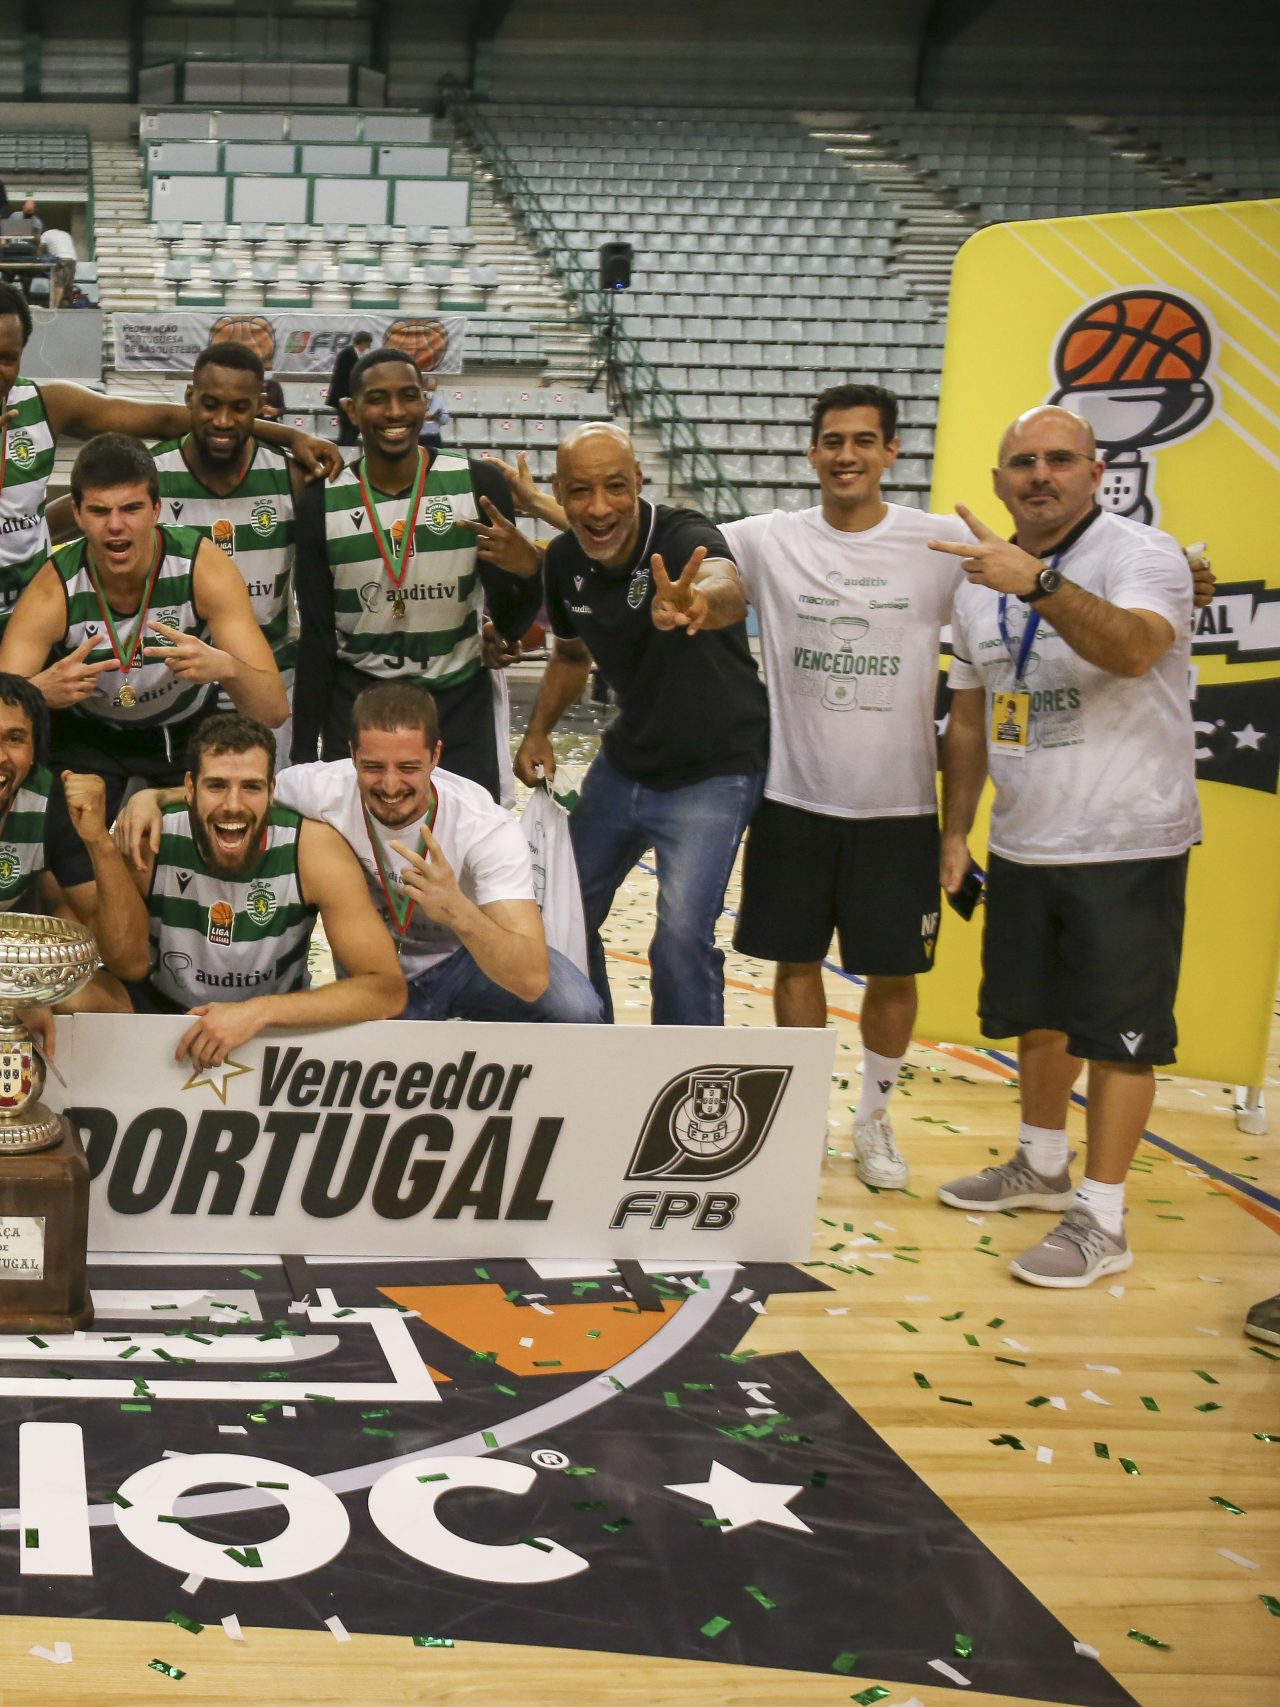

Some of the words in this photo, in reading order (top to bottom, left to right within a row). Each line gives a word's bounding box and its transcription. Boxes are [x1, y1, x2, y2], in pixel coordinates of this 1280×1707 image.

[385, 582, 456, 602] auditiv
[798, 593, 840, 608] macron
[156, 609, 177, 618] SCP
[793, 645, 902, 677] VENCEDORES
[250, 881, 272, 890] SCP
[211, 926, 230, 937] LIGA
[195, 968, 273, 988] auditiv
[258, 1046, 532, 1113] Vencedor
[608, 1190, 741, 1231] FPB
